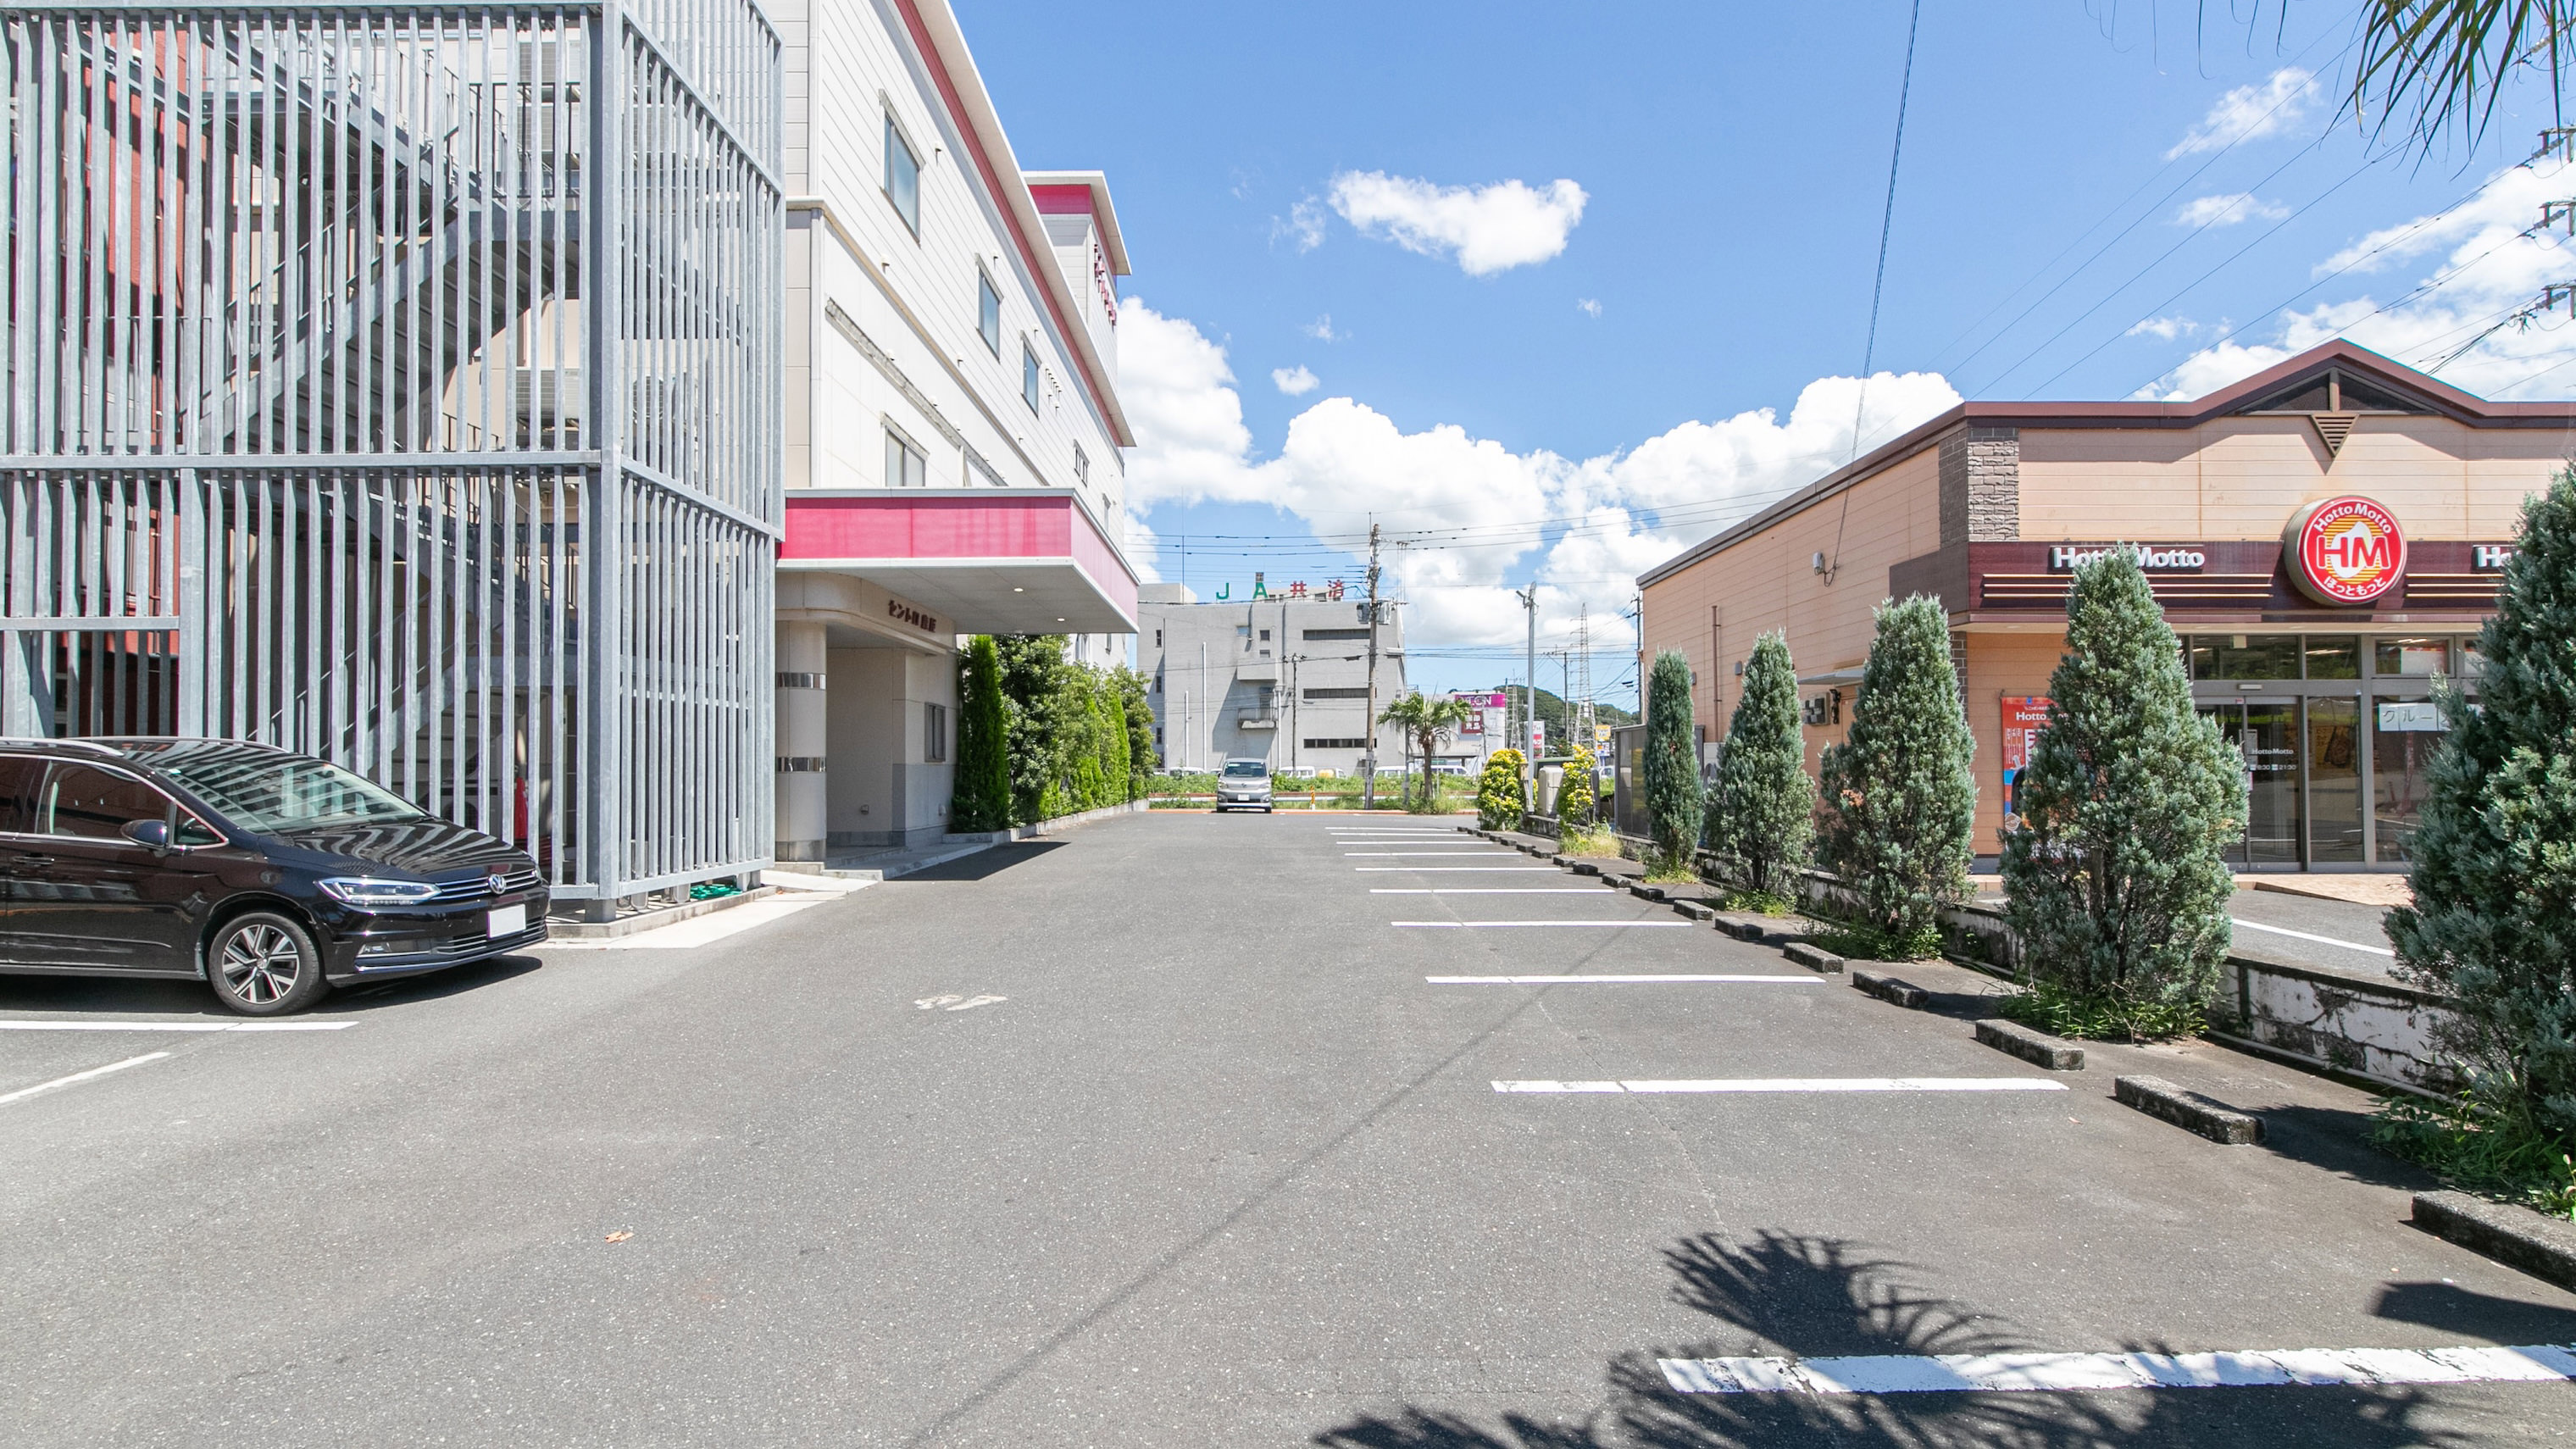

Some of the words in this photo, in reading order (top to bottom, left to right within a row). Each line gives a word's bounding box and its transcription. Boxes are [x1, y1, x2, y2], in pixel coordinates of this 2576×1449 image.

[2313, 505, 2353, 532] Hotto
[2354, 502, 2392, 535] Motto
[2135, 547, 2205, 568] Motto
[2316, 535, 2391, 569] HM
[2323, 576, 2386, 596] ほっともっと
[2016, 712, 2047, 721] Hotto
[2383, 710, 2450, 724] クルー
